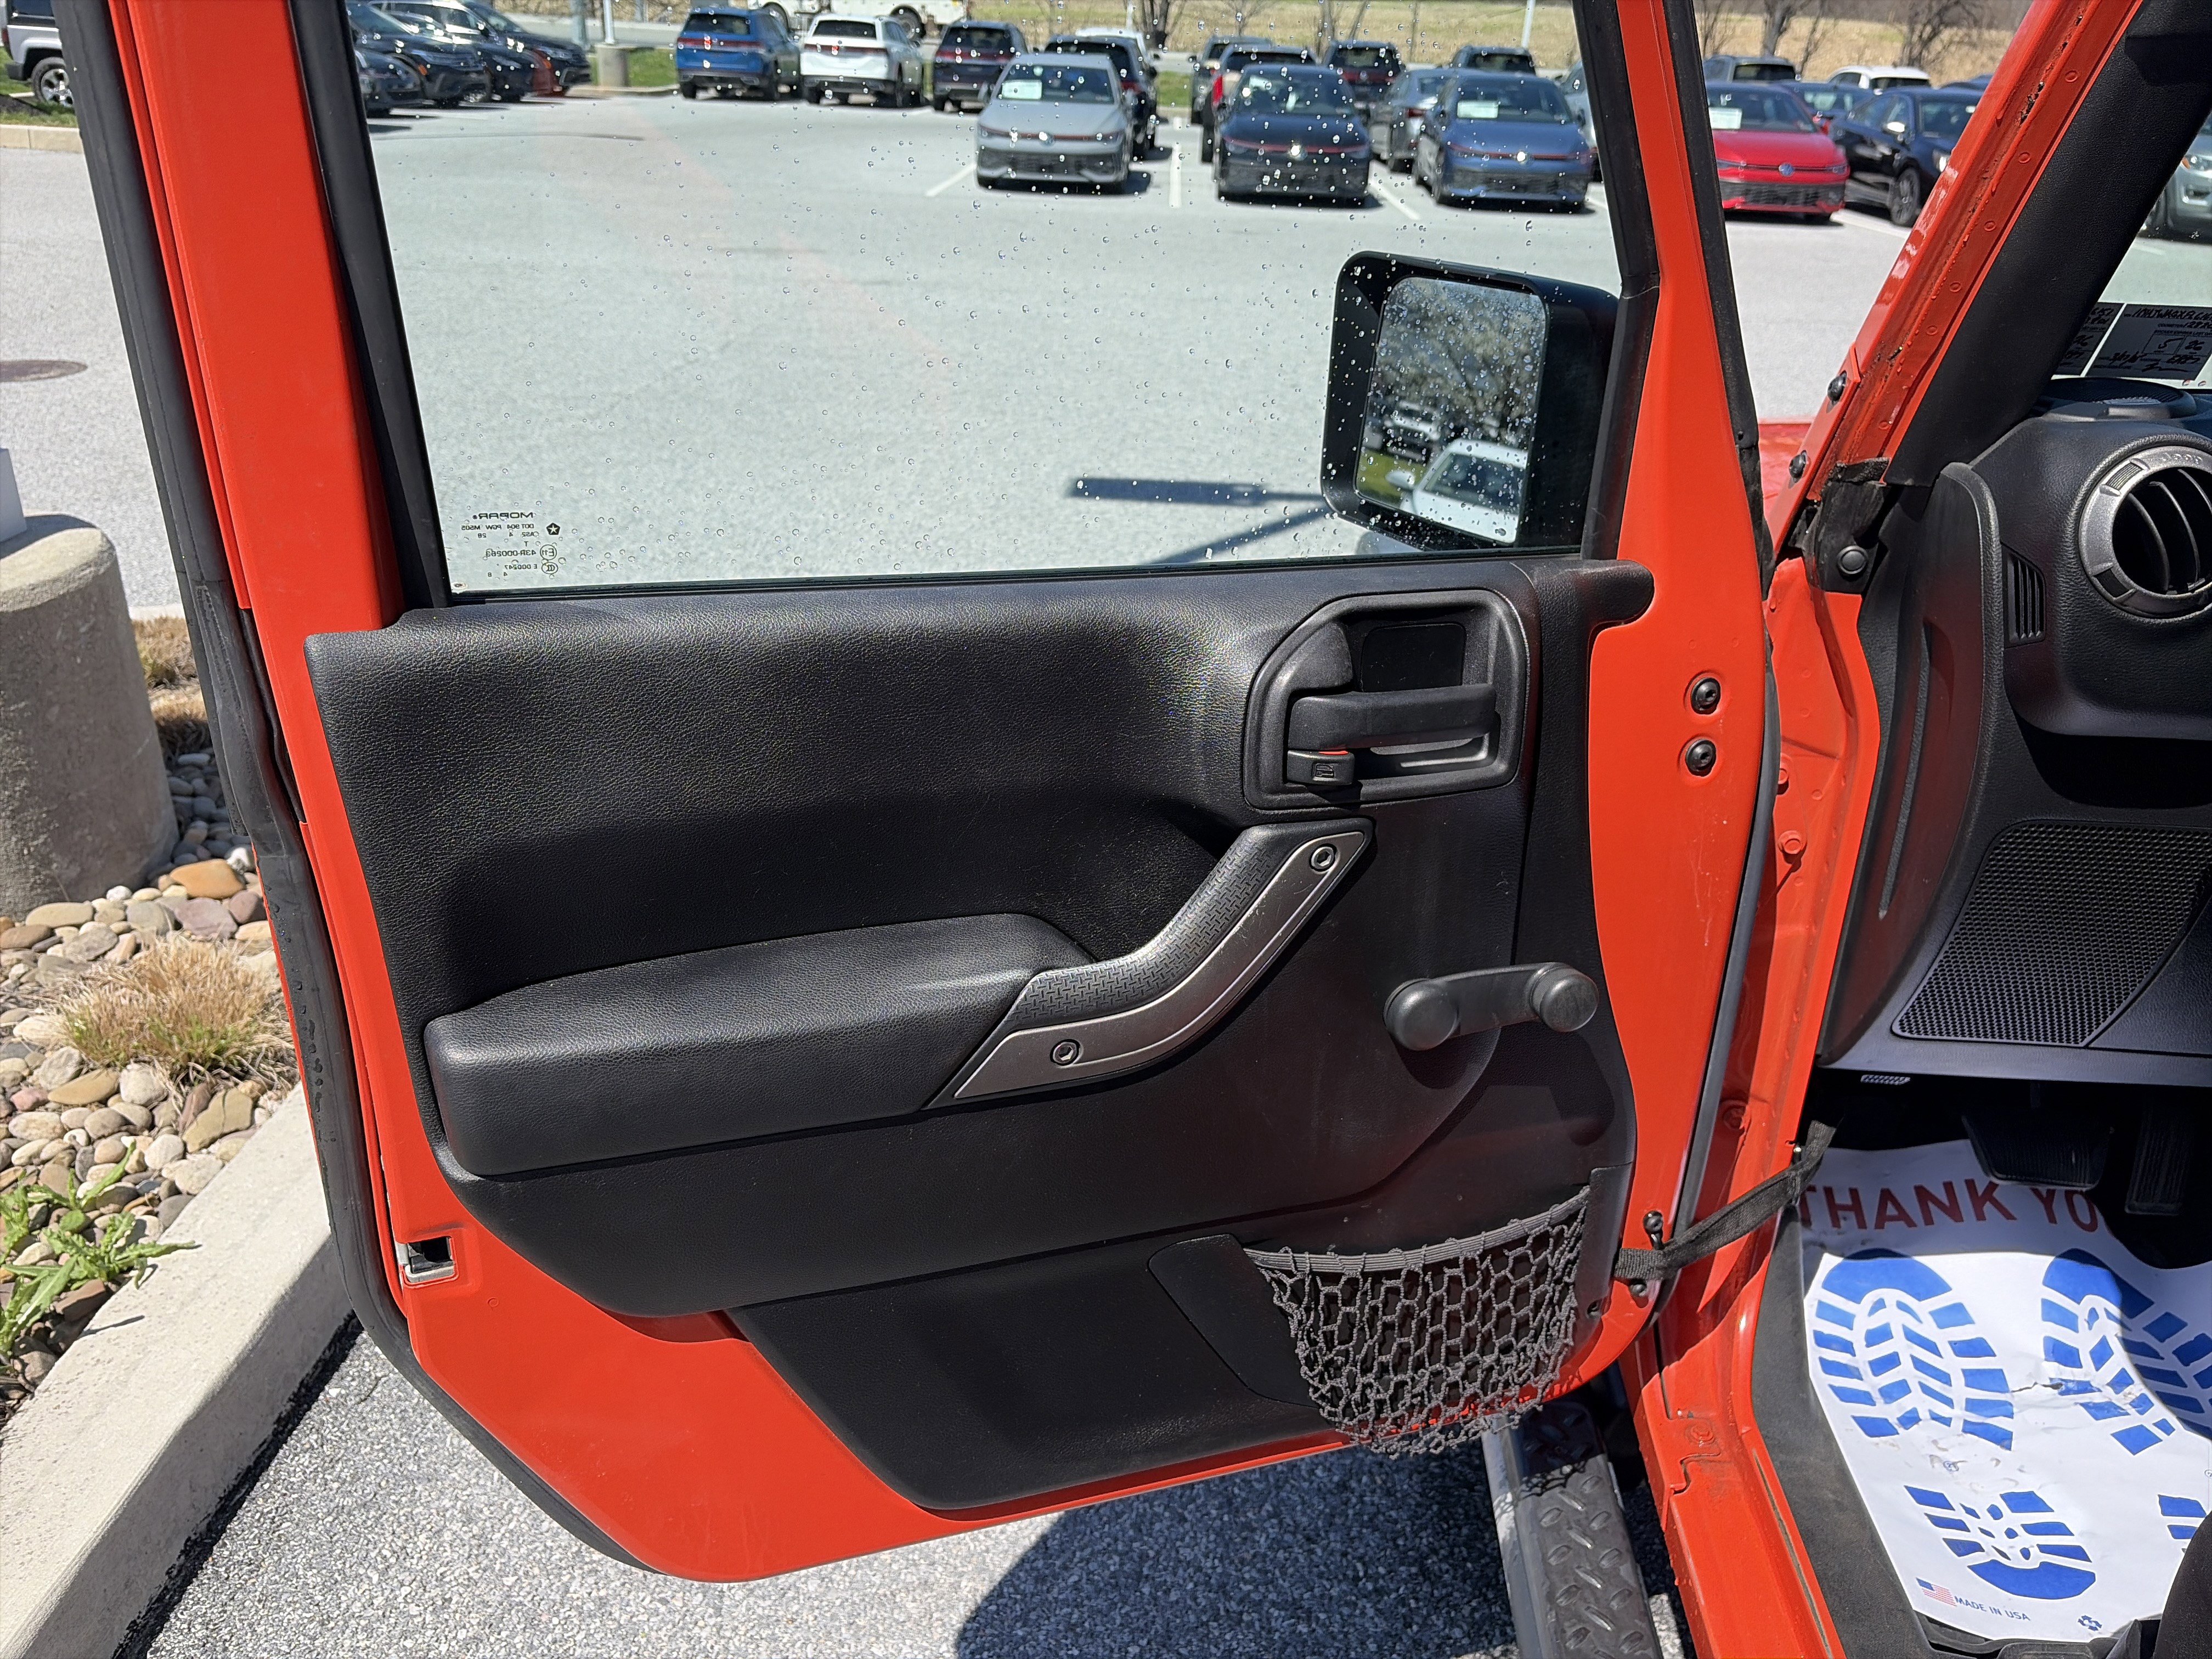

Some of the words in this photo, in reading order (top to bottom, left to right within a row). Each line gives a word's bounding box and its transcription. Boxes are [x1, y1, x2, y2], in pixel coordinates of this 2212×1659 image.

[1954, 1595, 1987, 1612] MADE
[1989, 1605, 2002, 1616] IN
[2004, 1609, 2032, 1622] USA
